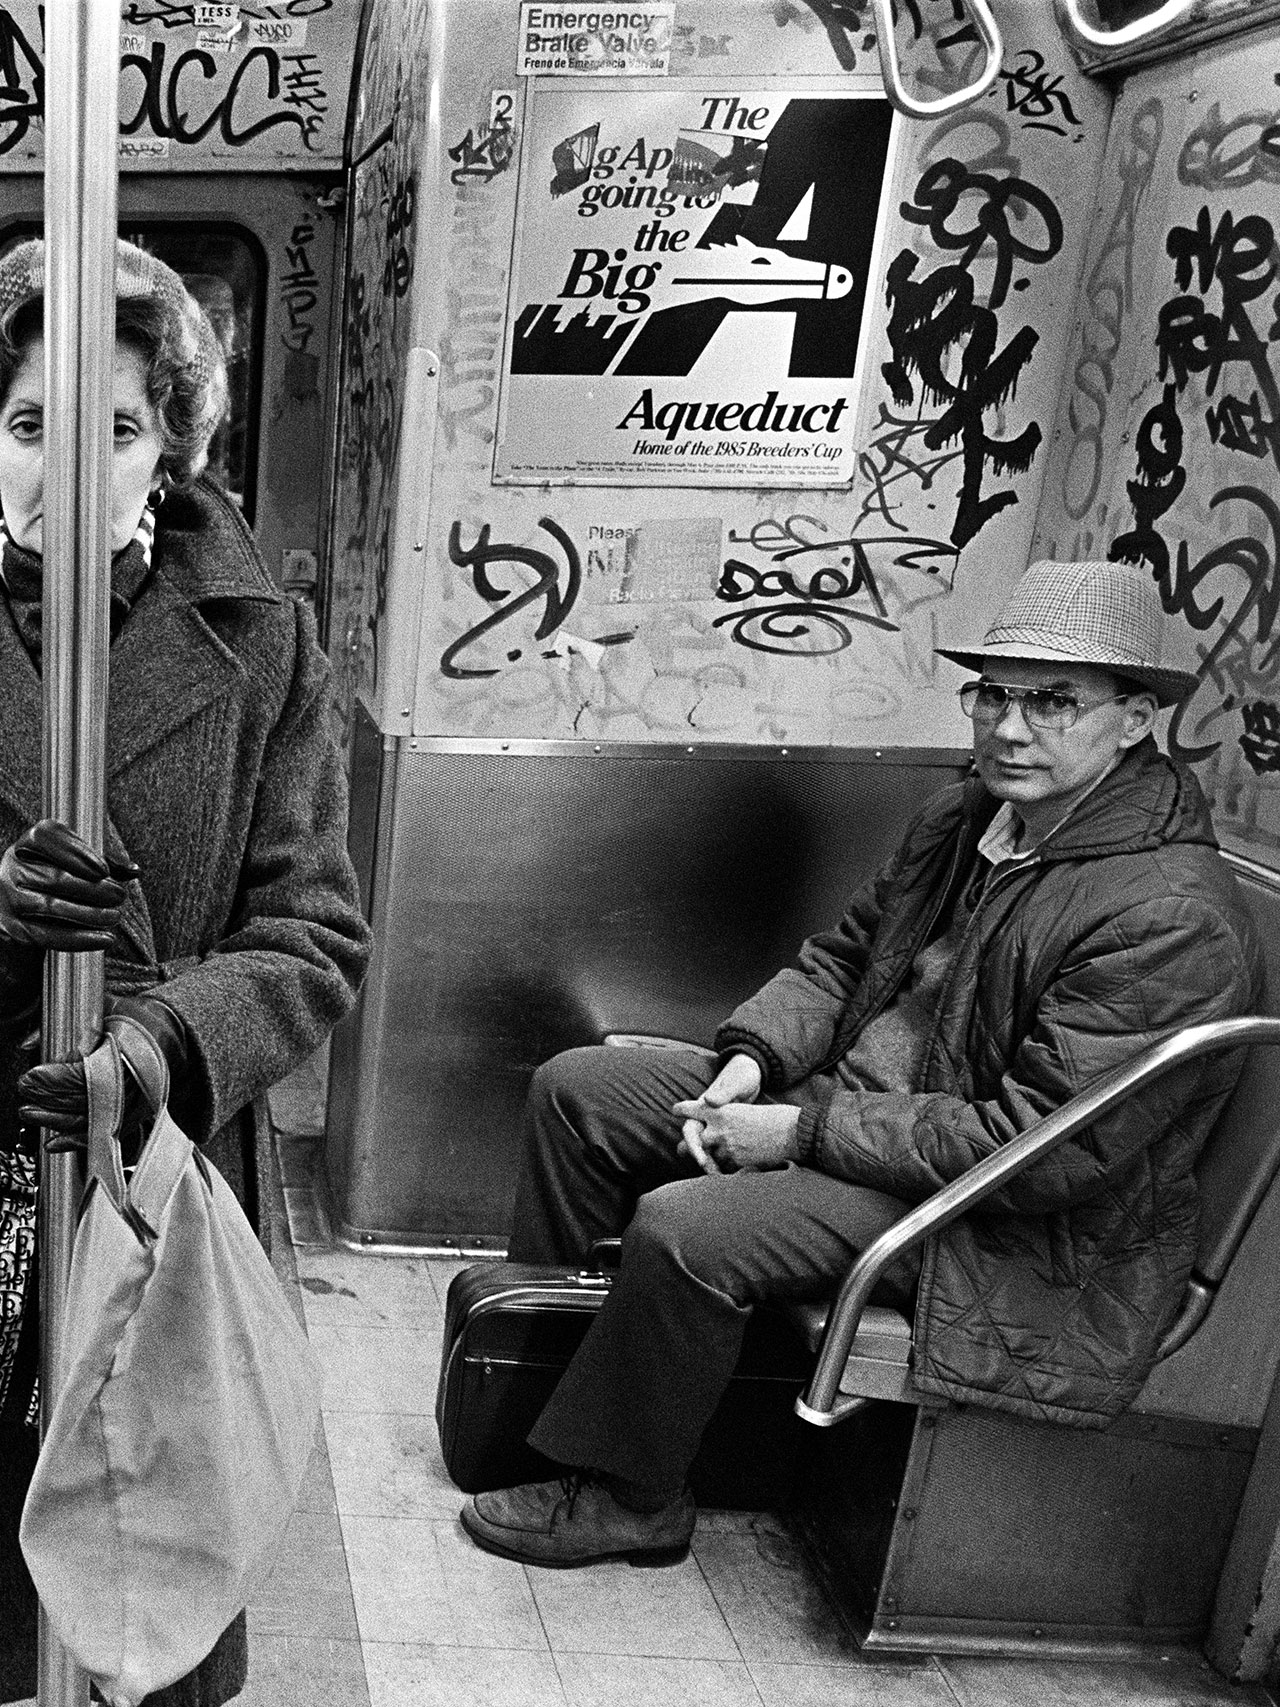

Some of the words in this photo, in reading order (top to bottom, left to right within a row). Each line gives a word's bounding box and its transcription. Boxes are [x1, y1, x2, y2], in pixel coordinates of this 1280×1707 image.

[201, 7, 232, 17] TESS
[527, 8, 656, 33] Emergency
[525, 32, 589, 52] Brake
[599, 33, 658, 53] Valve
[524, 58, 553, 68] Freno
[554, 57, 566, 68] de
[496, 95, 513, 121] 2
[700, 97, 770, 130] The
[577, 177, 678, 217] going
[634, 220, 690, 252] the
[557, 249, 662, 313] Big
[616, 388, 848, 440] Aqueduct
[632, 440, 672, 455] Home
[674, 441, 690, 455] of
[690, 441, 714, 456] the
[714, 441, 747, 456] 1985
[747, 443, 815, 458] Breeders'
[814, 443, 842, 461] Cup
